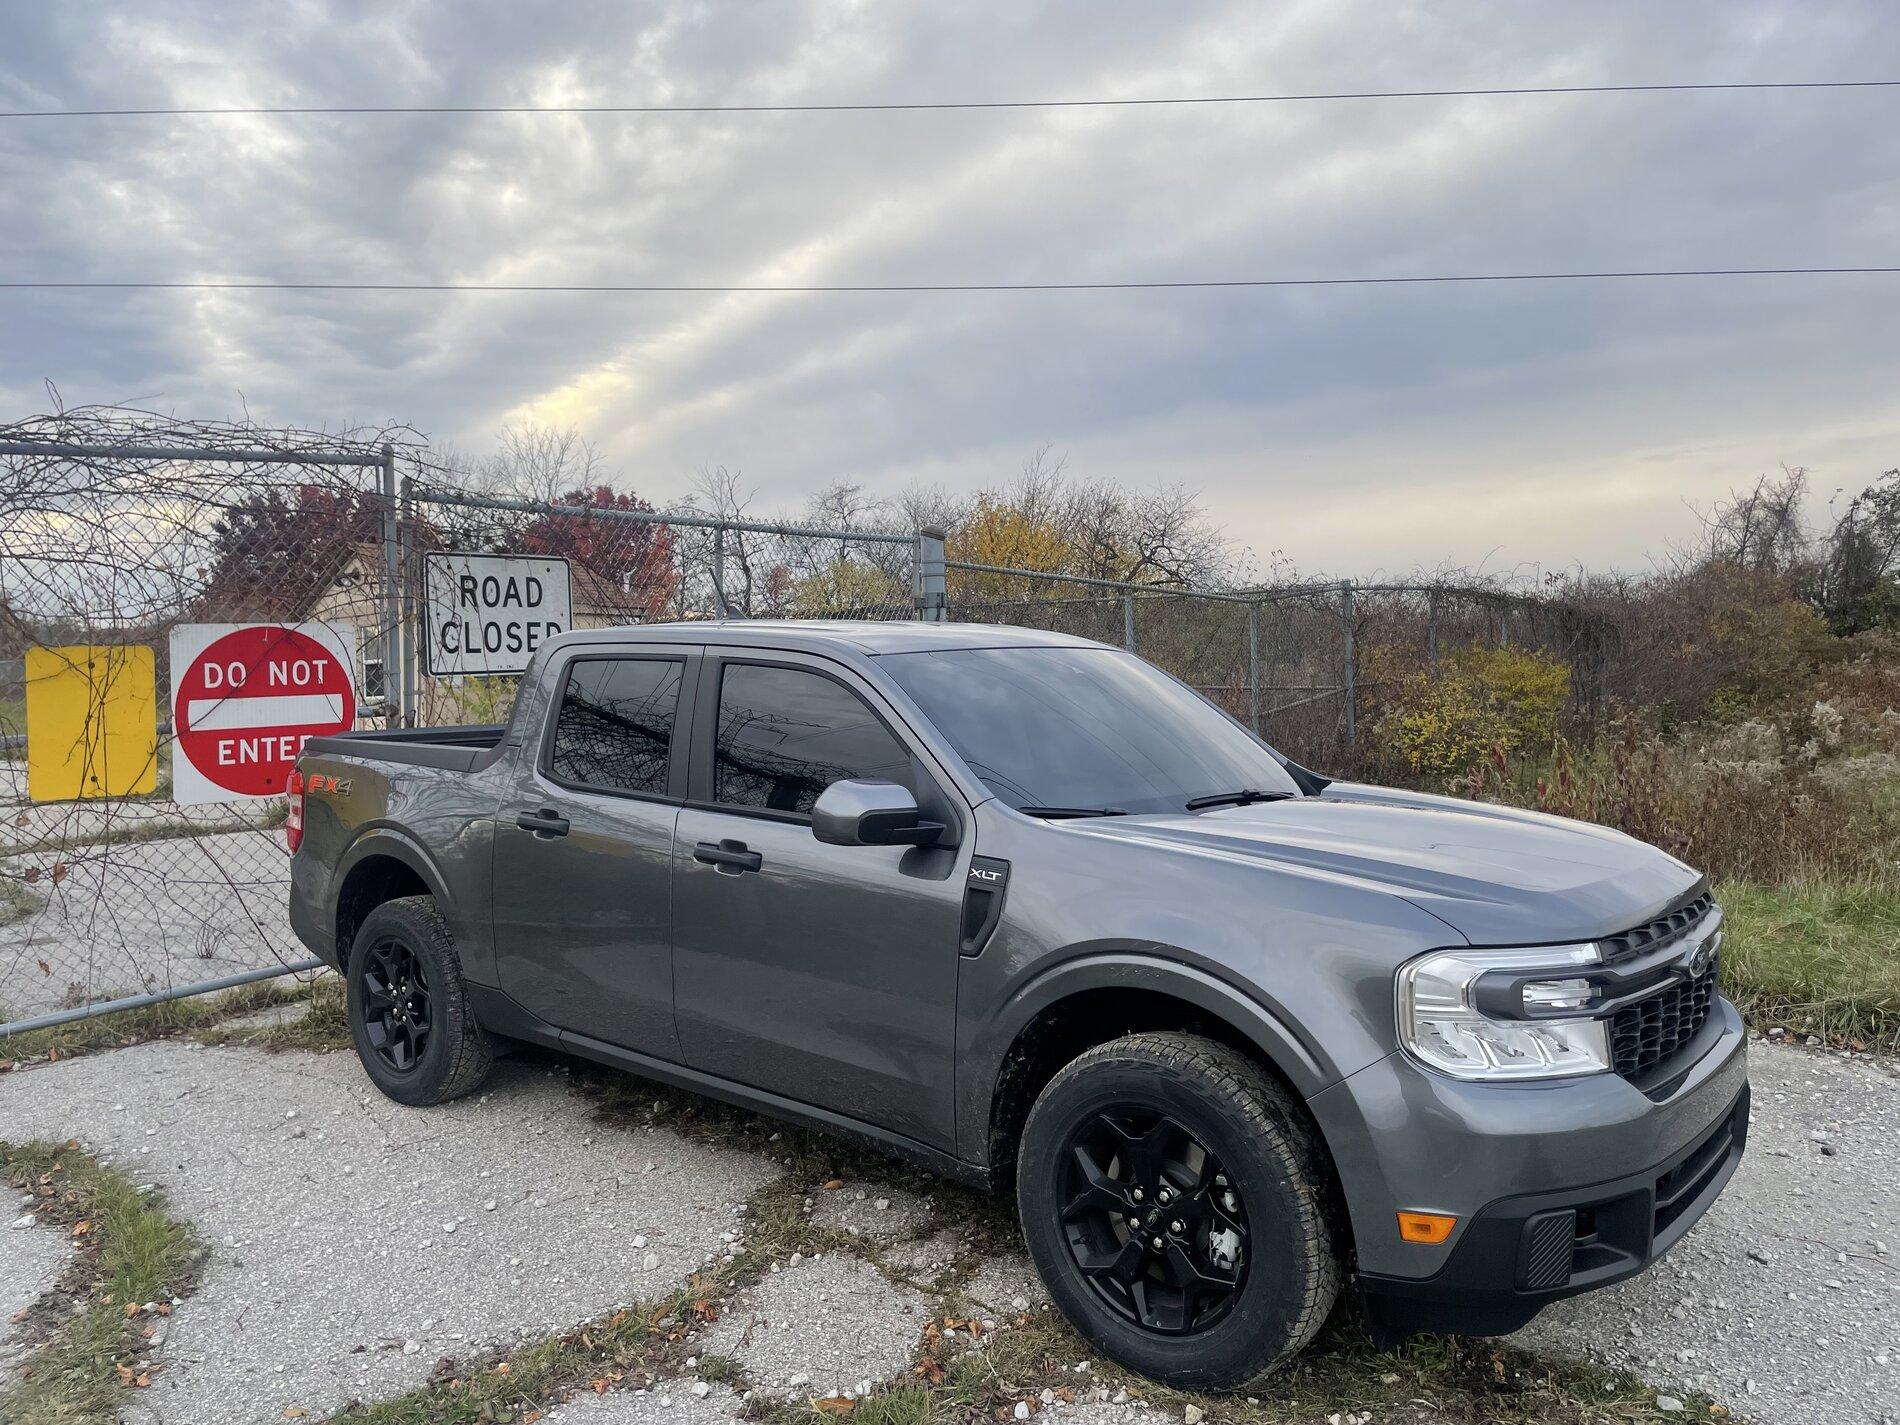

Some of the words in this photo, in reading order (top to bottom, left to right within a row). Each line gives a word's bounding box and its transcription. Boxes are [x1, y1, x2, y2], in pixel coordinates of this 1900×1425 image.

[460, 575, 543, 608] ROAD
[204, 661, 247, 689] DO
[269, 659, 328, 687] NOT
[308, 774, 354, 796] FX4
[969, 868, 1002, 880] XLT
